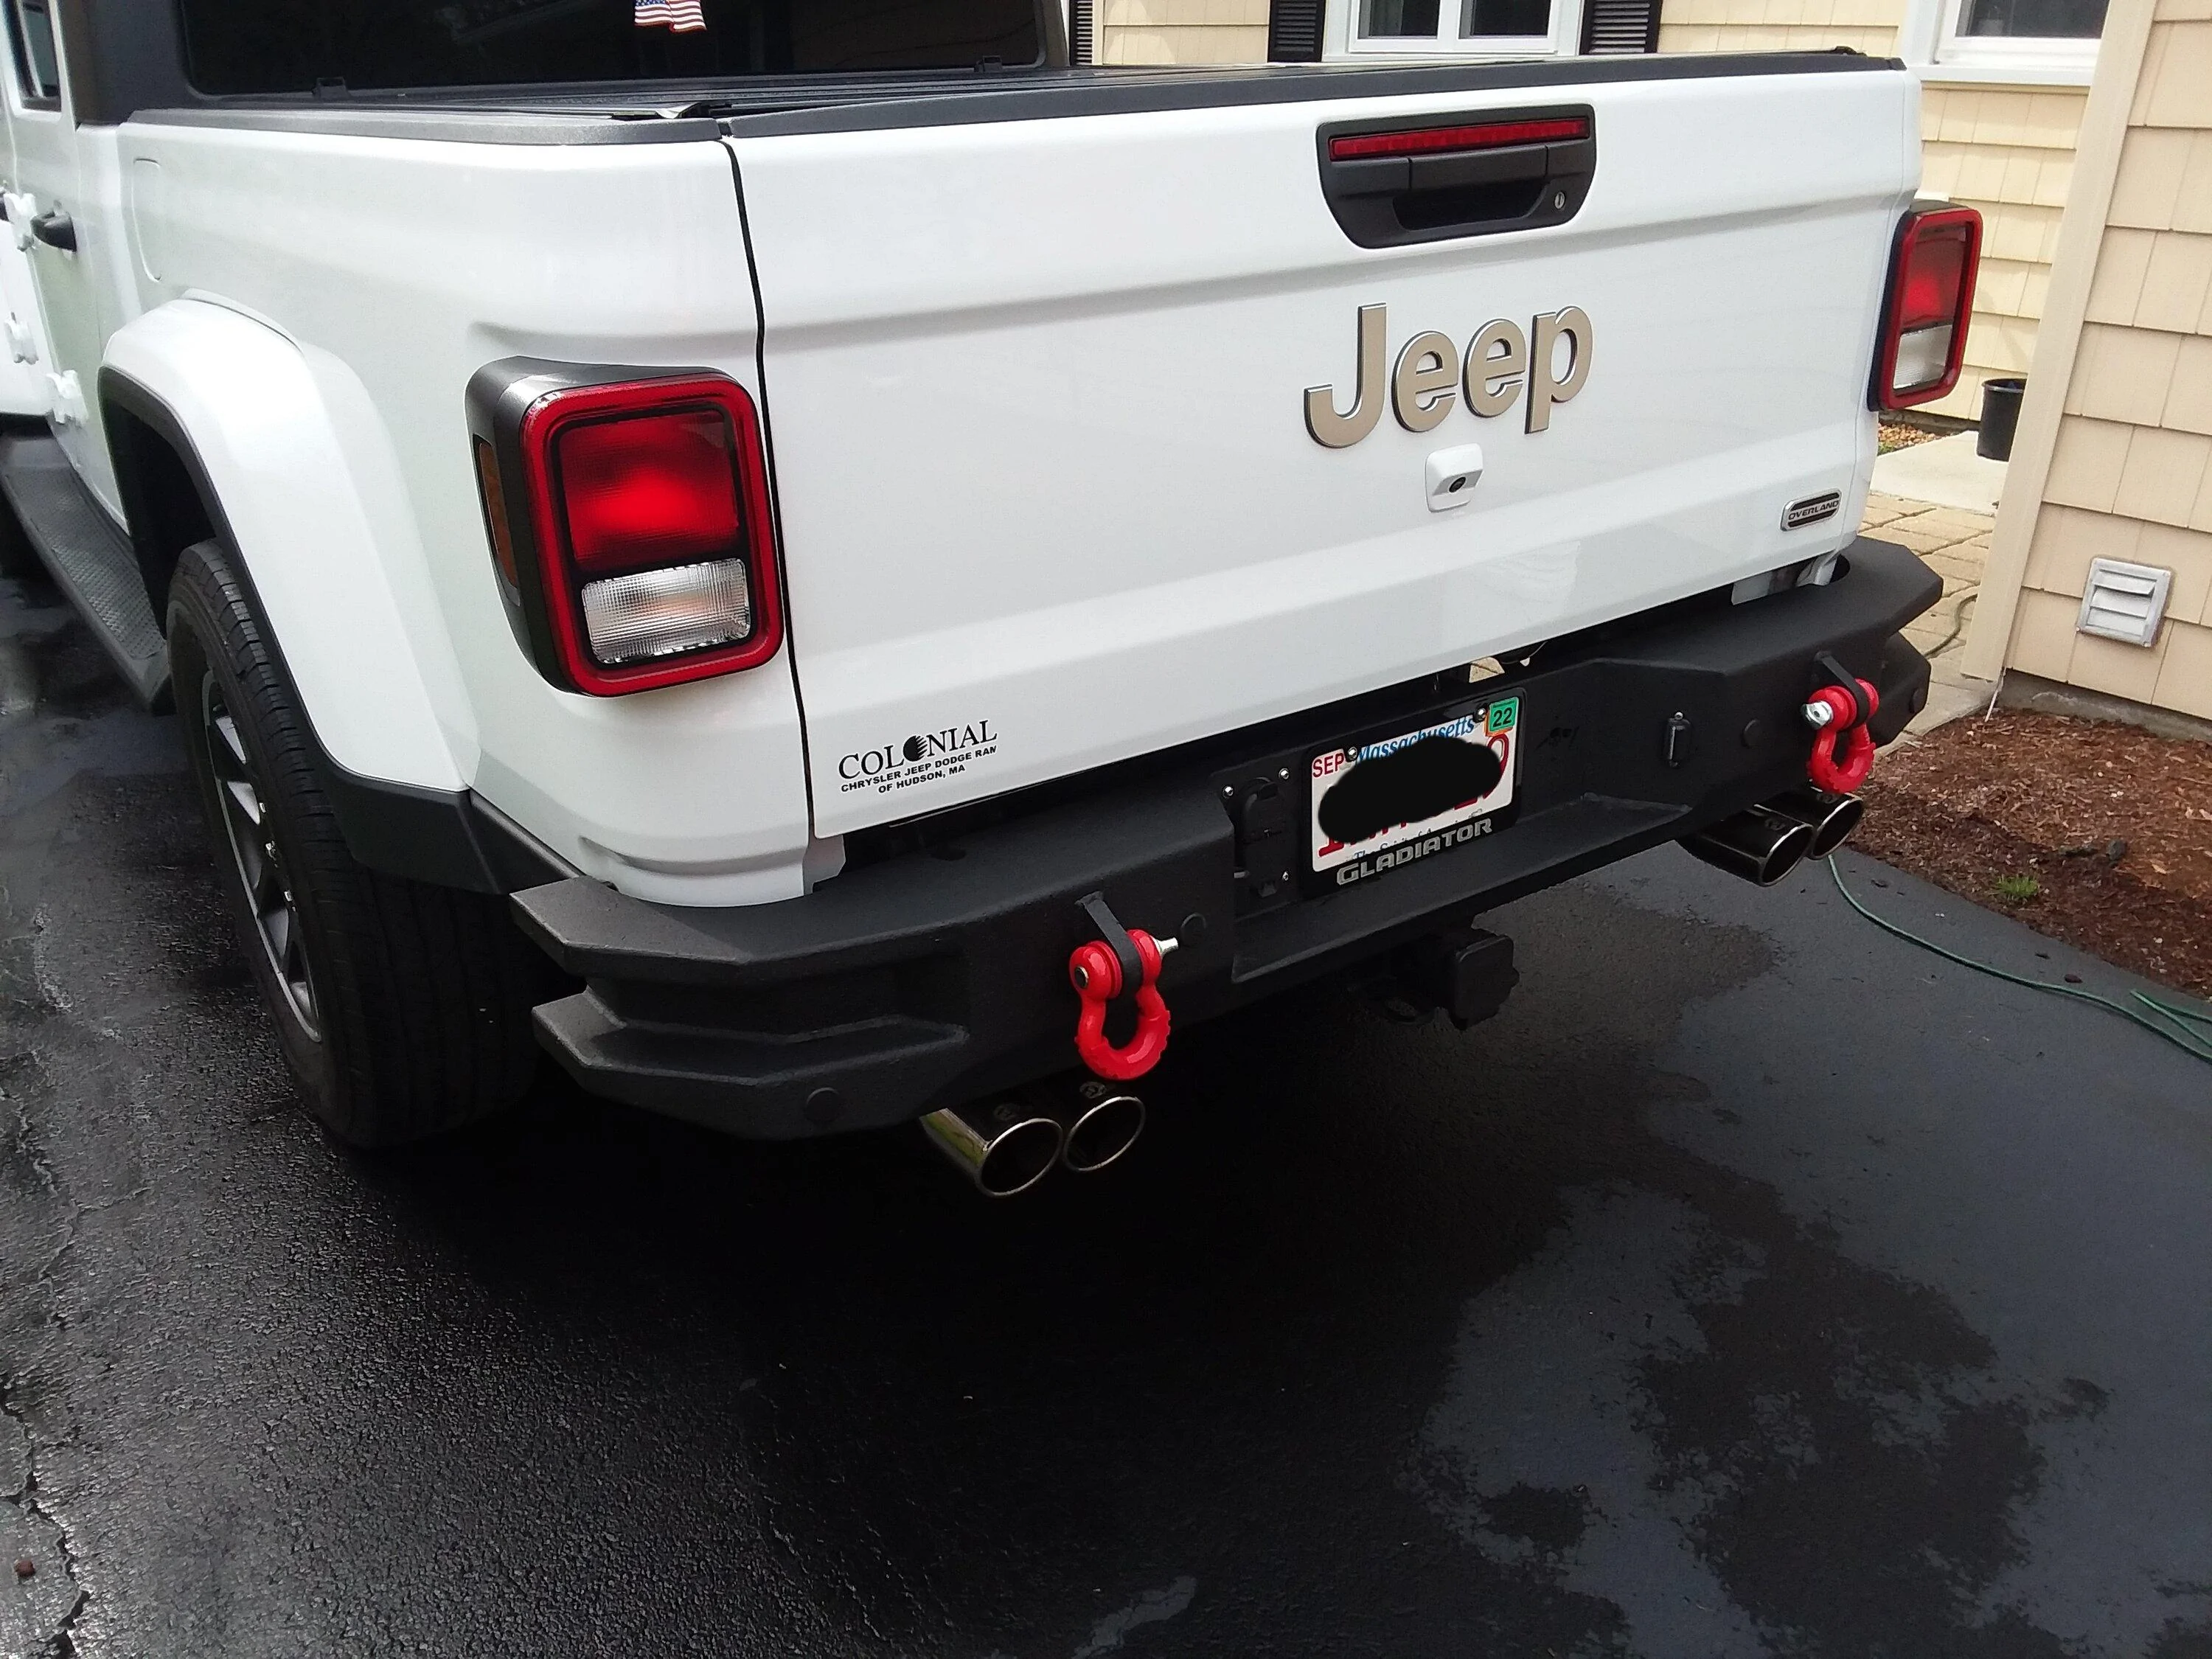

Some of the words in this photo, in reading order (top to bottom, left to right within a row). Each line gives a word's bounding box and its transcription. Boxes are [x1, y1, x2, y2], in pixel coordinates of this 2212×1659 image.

[1304, 302, 1593, 448] Jeep
[1788, 500, 1839, 521] OVERLAND
[1492, 706, 1513, 727] 22
[841, 770, 901, 793] CHRYSLER
[904, 763, 932, 777] JEEP
[935, 751, 973, 769] DODGE
[878, 784, 894, 793] OF
[896, 770, 946, 790] HUDSON,
[948, 764, 966, 776] MA
[1312, 752, 1345, 778] SEP
[1336, 817, 1493, 886] GLADIATOR
